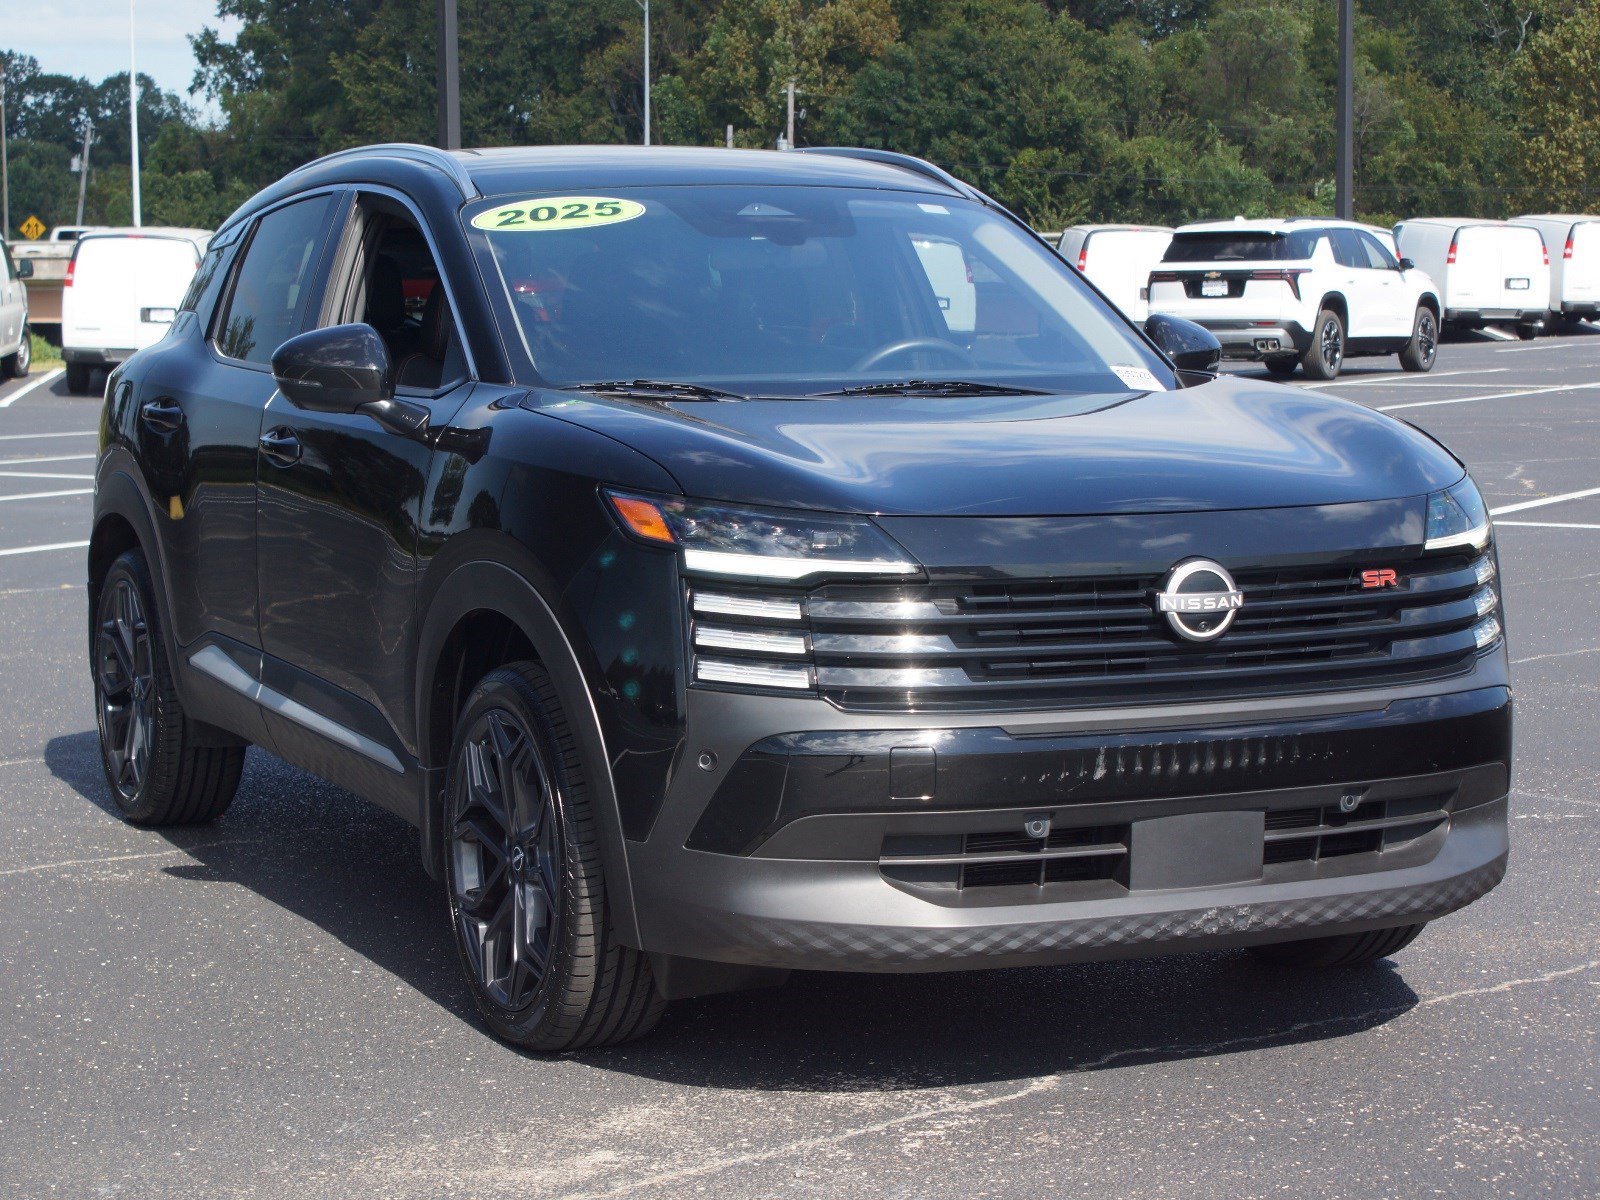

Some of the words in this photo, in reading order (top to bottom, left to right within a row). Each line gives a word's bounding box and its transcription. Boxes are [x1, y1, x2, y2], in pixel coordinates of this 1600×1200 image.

[496, 201, 622, 227] 2025
[1362, 569, 1397, 588] SR
[1162, 594, 1243, 610] NISSAN
